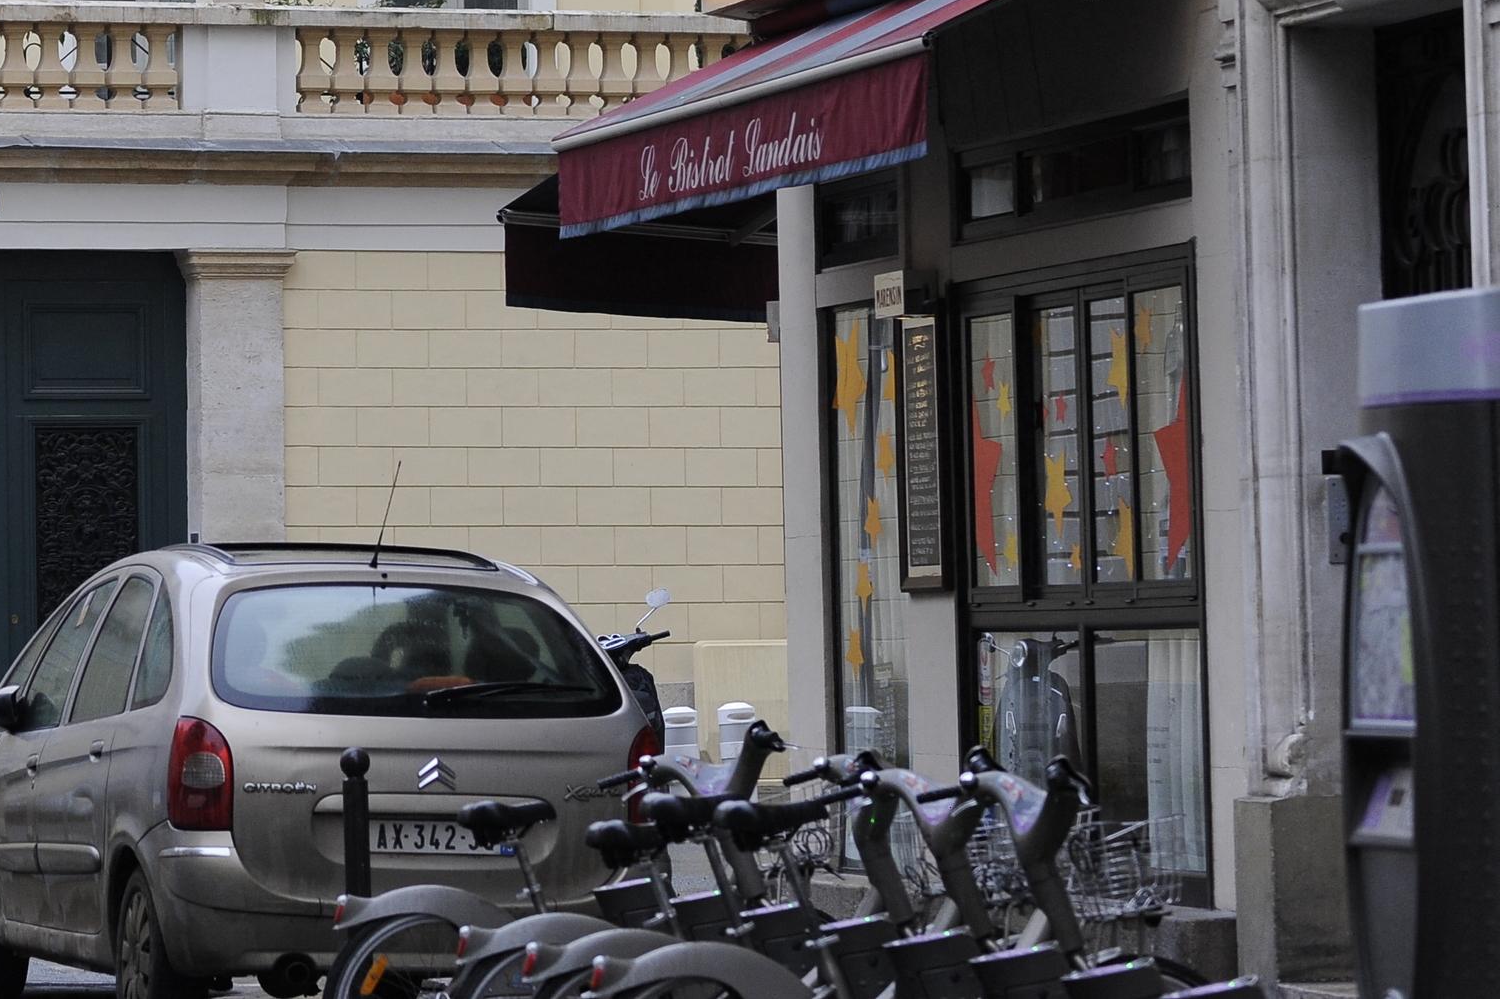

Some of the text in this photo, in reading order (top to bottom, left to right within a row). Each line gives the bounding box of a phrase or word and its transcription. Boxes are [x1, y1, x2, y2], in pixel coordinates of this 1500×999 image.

[638, 112, 825, 200] Le Bistrot Landais
[243, 781, 317, 794] CITROËN
